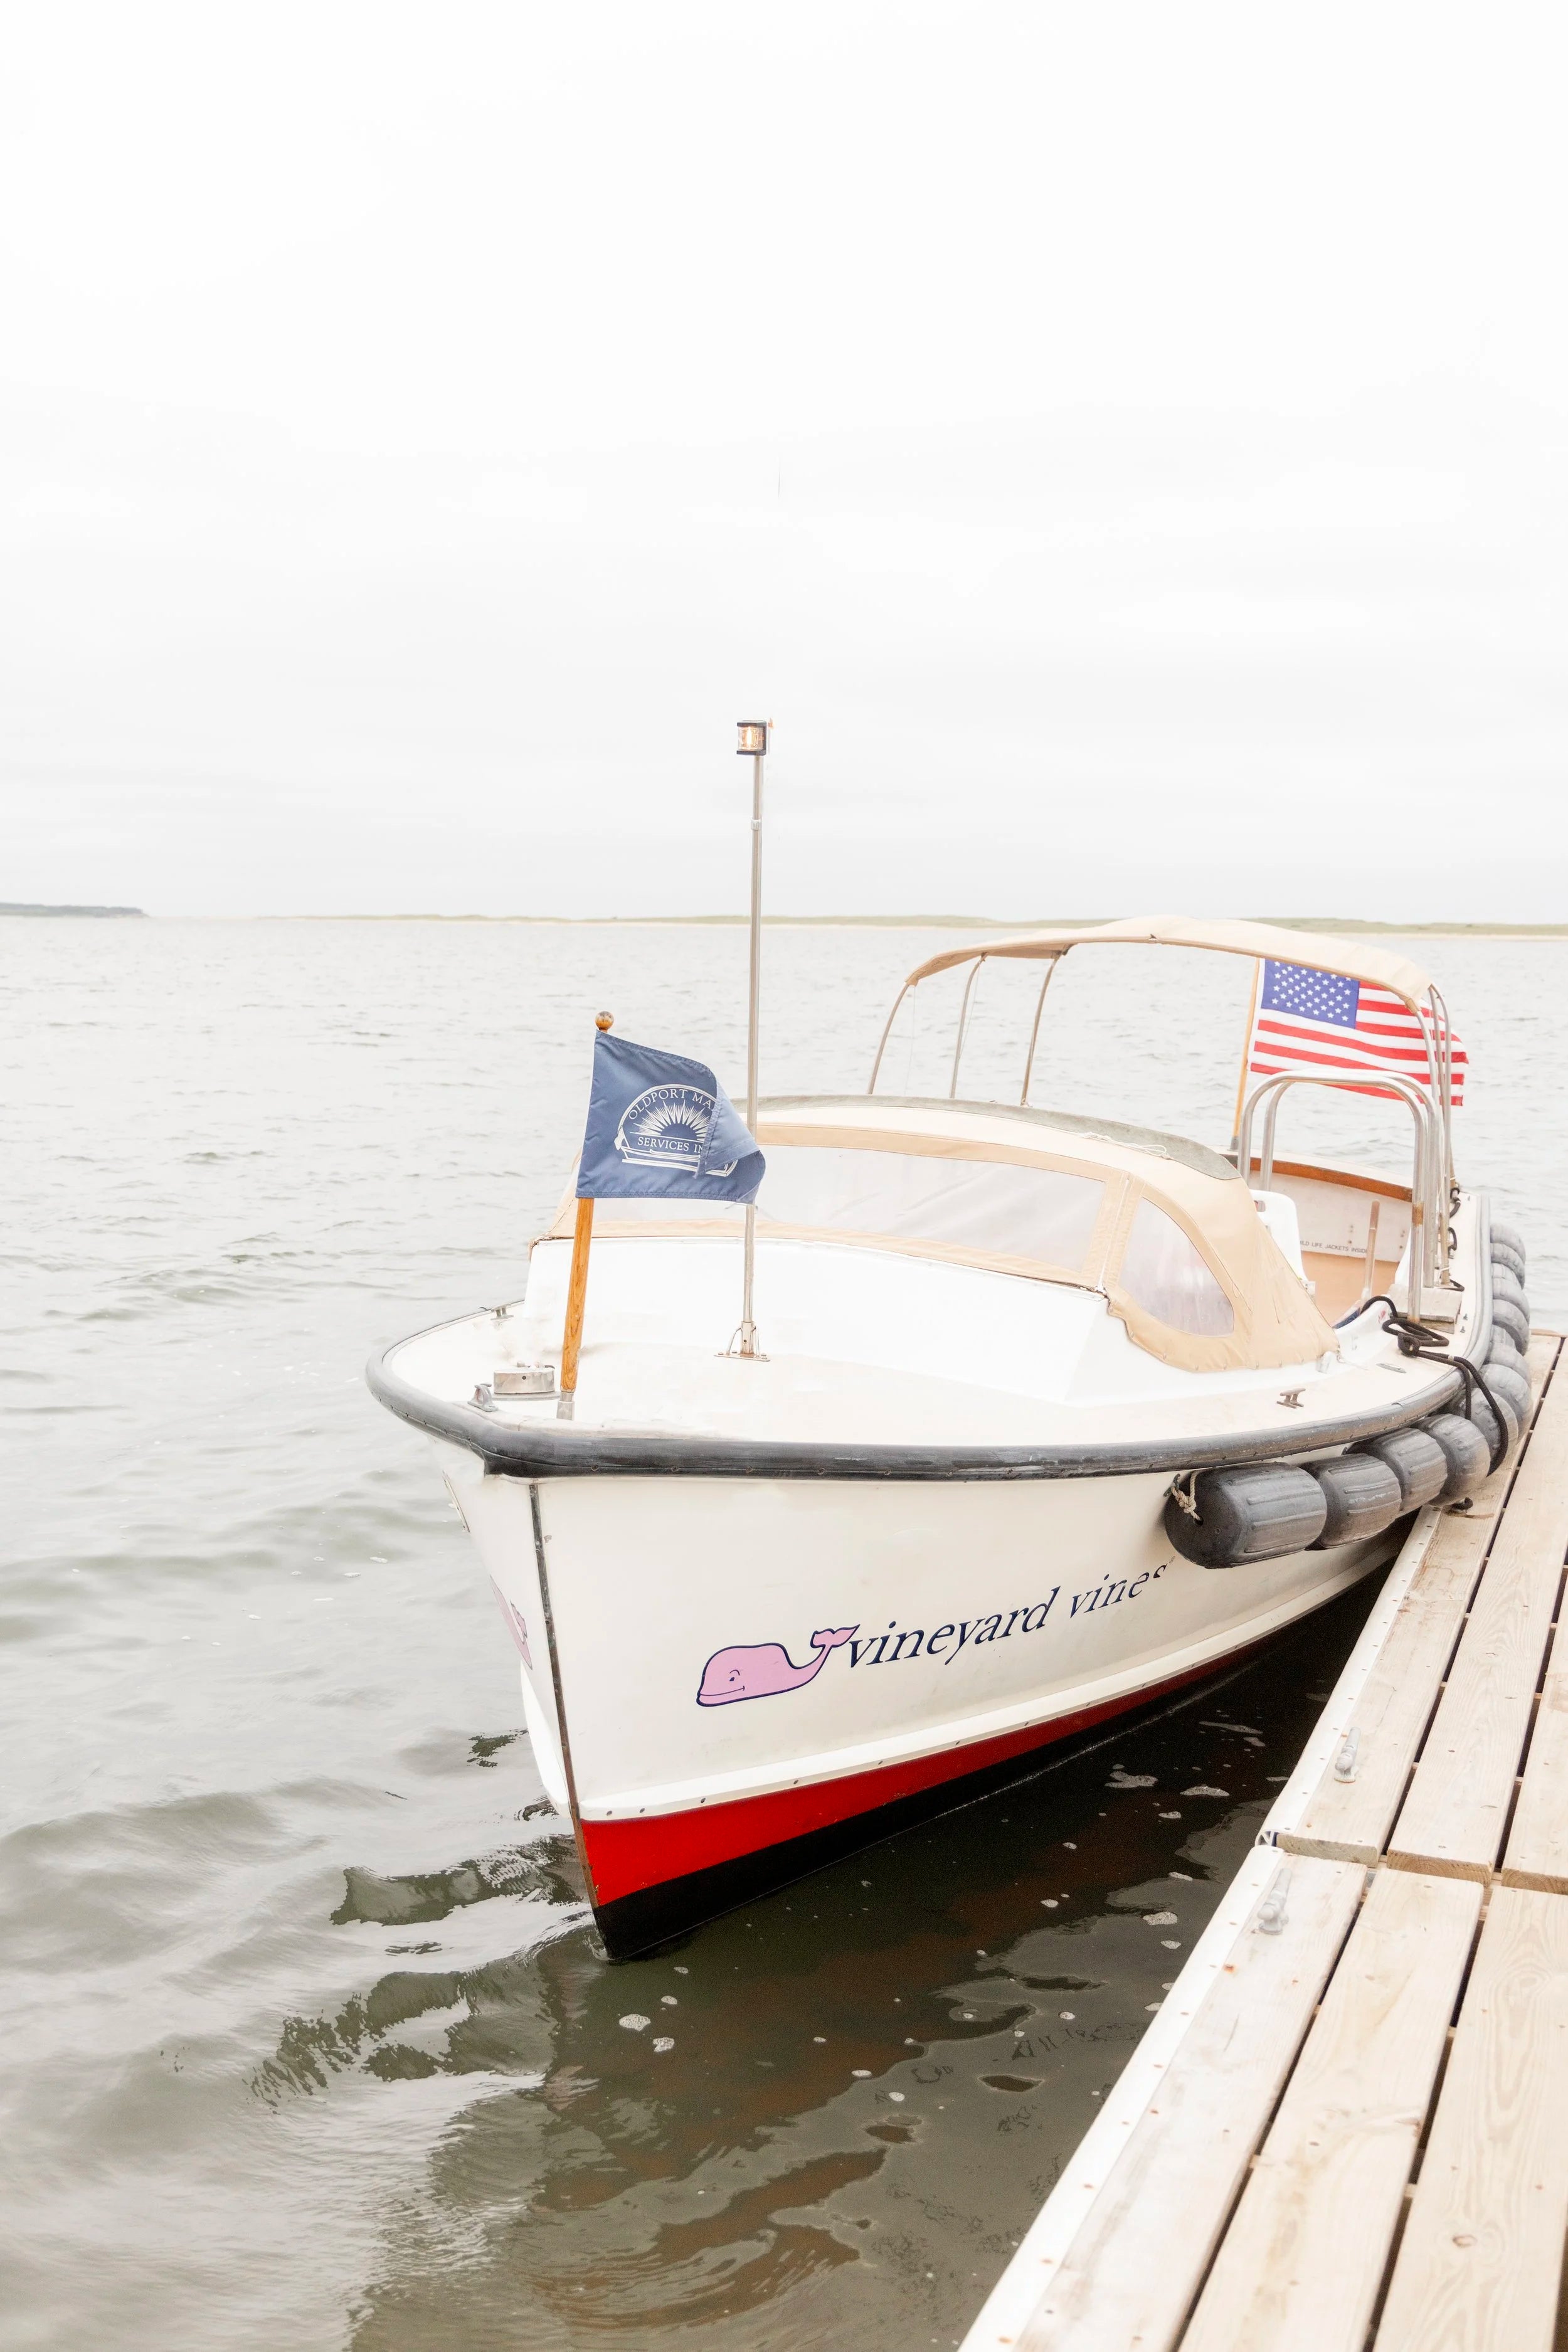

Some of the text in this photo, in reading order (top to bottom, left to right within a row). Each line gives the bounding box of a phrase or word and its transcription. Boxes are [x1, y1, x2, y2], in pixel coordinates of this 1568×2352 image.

[628, 1088, 712, 1120] OLDPORT MA
[637, 1136, 703, 1153] SERVICES IN
[848, 1586, 1061, 1669] vineyard
